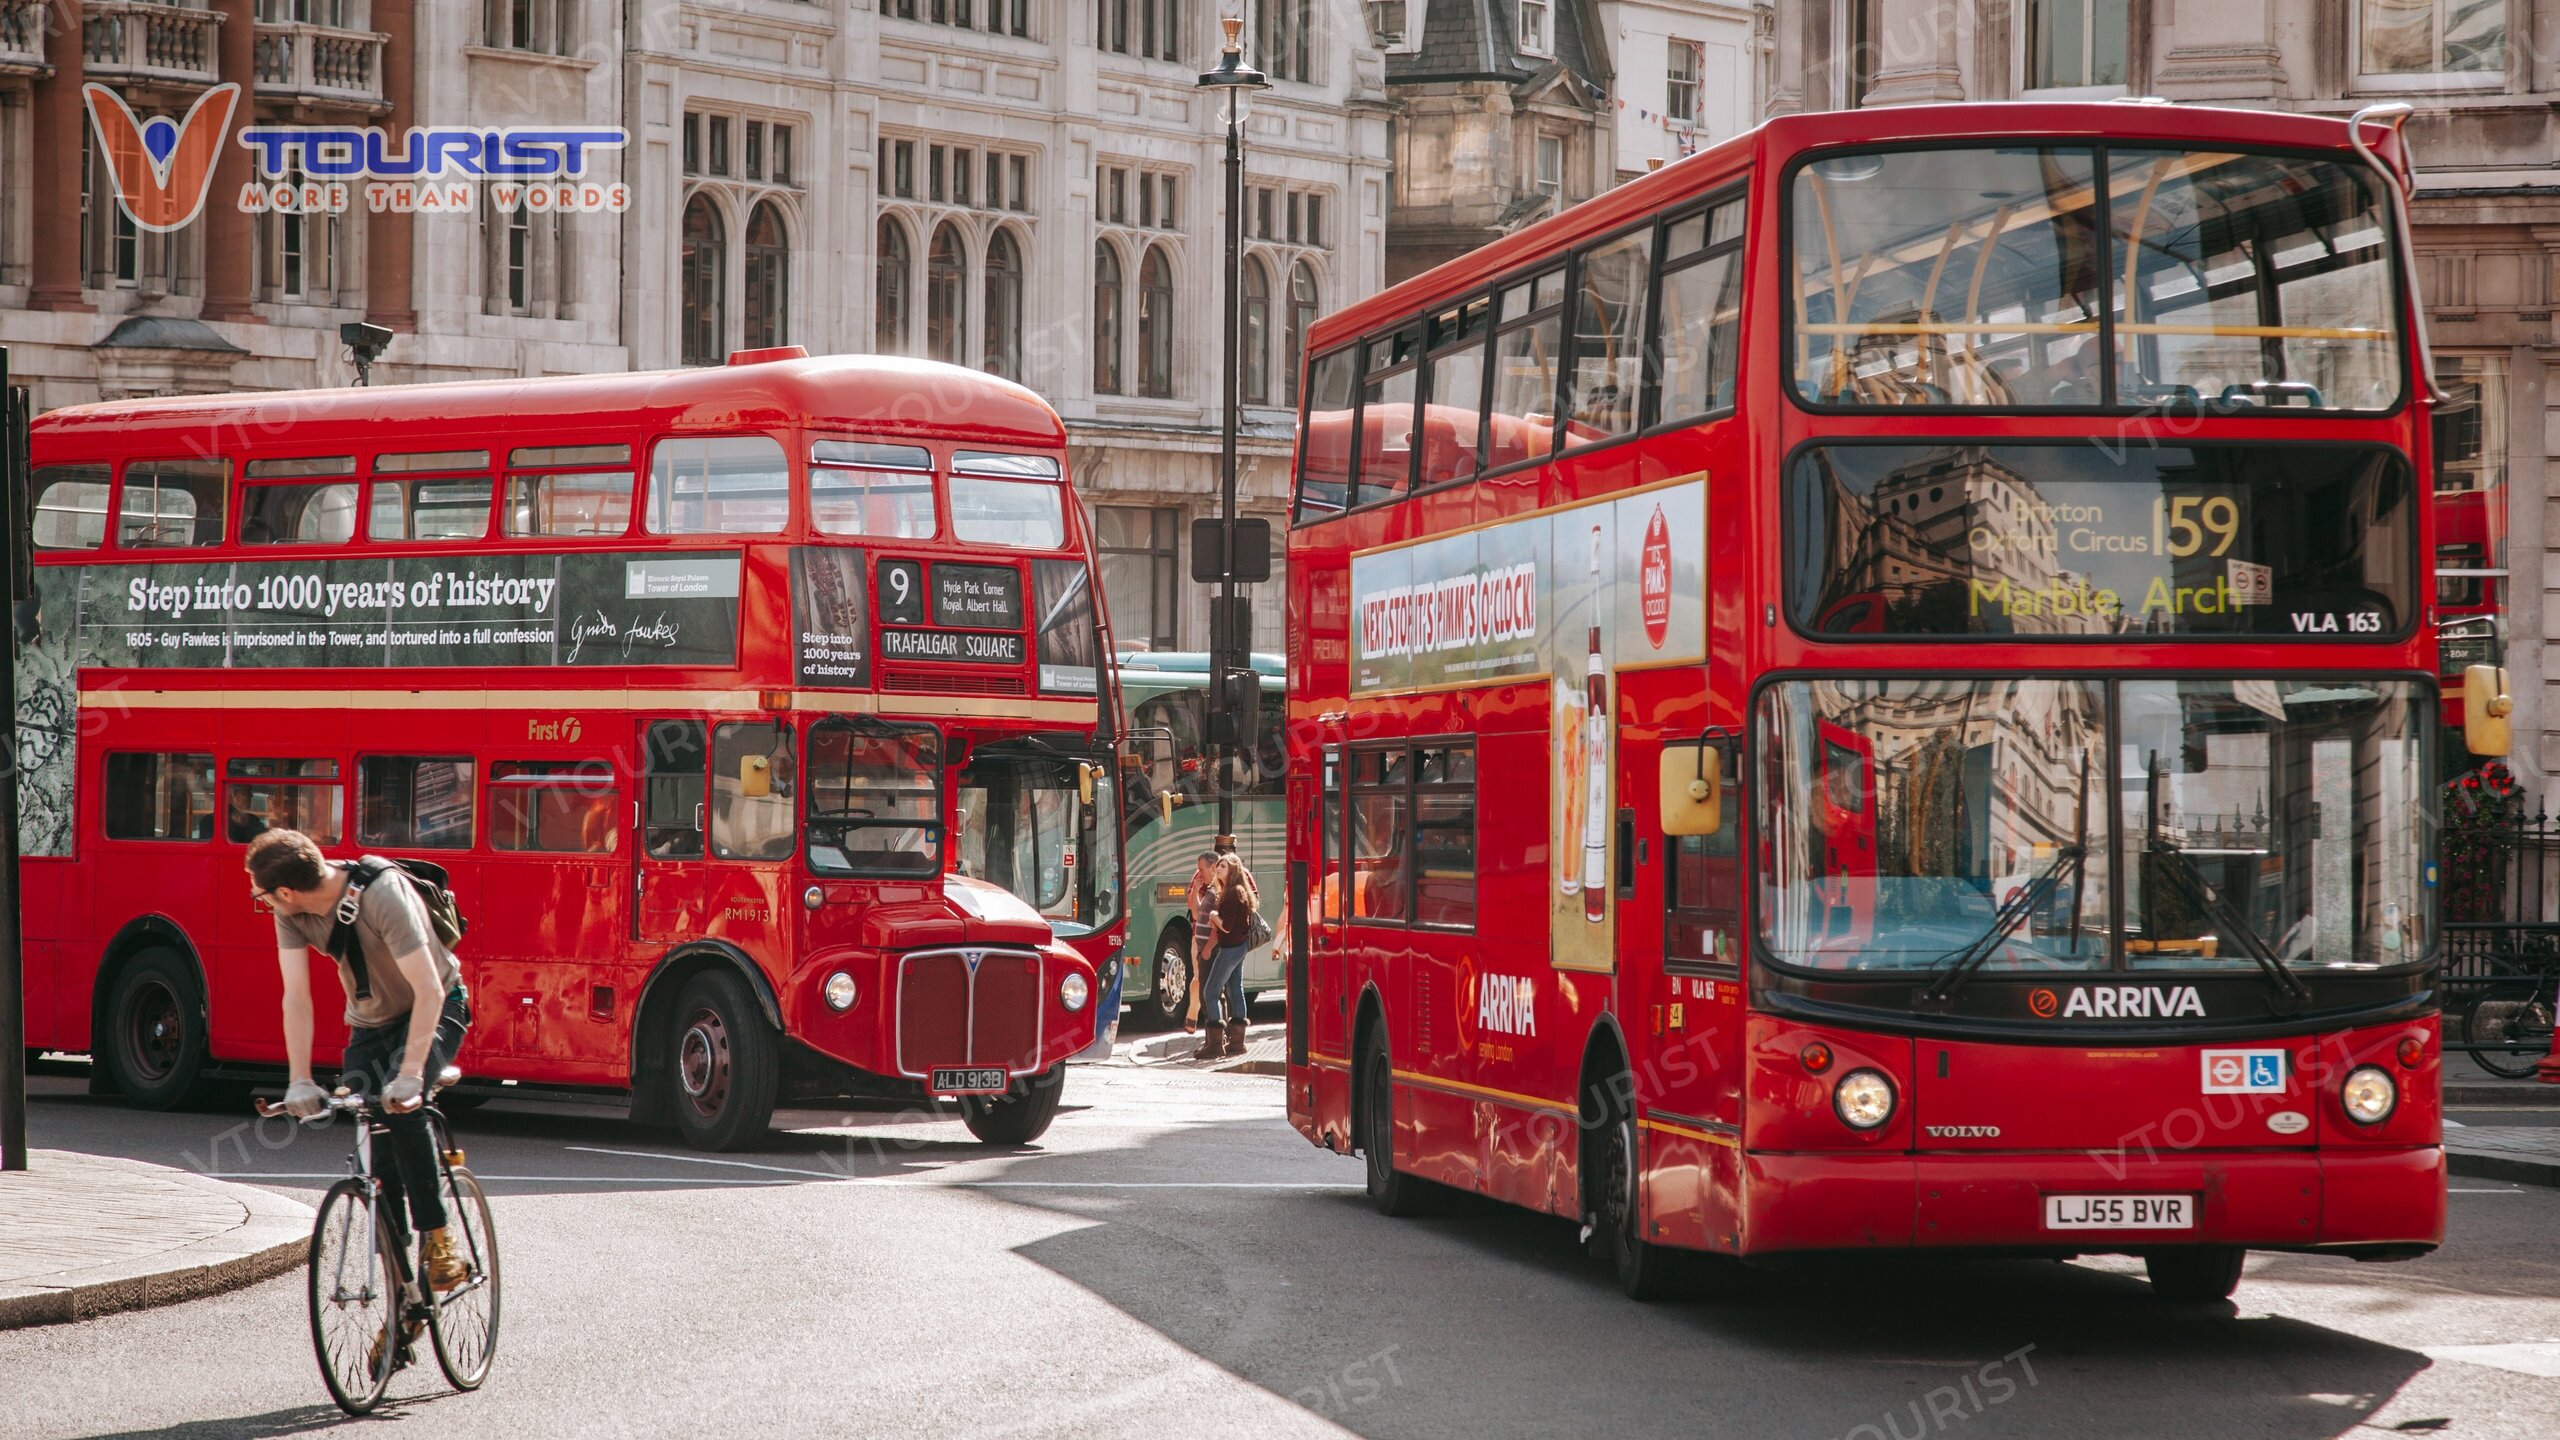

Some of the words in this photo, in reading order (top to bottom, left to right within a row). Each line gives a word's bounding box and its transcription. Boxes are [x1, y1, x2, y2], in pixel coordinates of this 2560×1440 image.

[2013, 497, 2102, 524] Brixton
[2152, 495, 2240, 558] 159
[1968, 526, 2058, 554] Oxford
[2069, 527, 2148, 554] Circus
[127, 577, 190, 618] Step
[193, 577, 251, 610] into
[257, 574, 322, 609] 1000
[325, 581, 405, 617] years
[411, 573, 442, 608] of
[446, 571, 556, 613] history
[647, 583, 670, 592] Tower
[670, 583, 679, 592] of
[679, 582, 708, 592] London
[889, 567, 910, 605] 9
[943, 580, 961, 595] Hyde
[964, 581, 979, 595] Park
[983, 582, 1005, 595] Corner
[1970, 577, 2120, 617] Marble
[2141, 575, 2243, 615] Arch
[943, 597, 963, 612] Royal
[966, 598, 990, 613] Albert
[992, 599, 1008, 613] Hall
[1362, 599, 1386, 654] NEXT
[1414, 591, 1435, 648] IT'S
[1437, 583, 1476, 646] PIMM'S
[1481, 572, 1535, 638] O'CLOCK!
[2291, 612, 2340, 633] VLA
[2346, 612, 2382, 633] 163
[126, 632, 152, 647] 1605
[161, 632, 180, 649] Guy
[182, 632, 220, 648] Fawkes
[222, 631, 232, 647] is
[233, 631, 295, 648] imprisoned
[296, 630, 306, 646] in
[308, 630, 326, 646] the
[329, 630, 363, 647] Tower,
[365, 630, 386, 646] and
[390, 629, 437, 646] tortured
[439, 628, 460, 644] into
[463, 632, 471, 644] a
[472, 628, 491, 644] full
[492, 628, 554, 644] confession
[802, 632, 829, 647] Step
[830, 633, 852, 644] into
[885, 631, 958, 655] TRAFALGAR
[966, 635, 1016, 658] SQUARE
[804, 648, 830, 660] 1000
[831, 650, 861, 663] years
[803, 663, 816, 675] of
[817, 664, 856, 678] history
[528, 719, 559, 740] First
[725, 907, 770, 922] RM1913
[1478, 972, 1536, 1037] ARRIVA
[2062, 986, 2206, 1018] ARRIVA
[936, 1072, 965, 1089] ALD
[967, 1072, 1001, 1088] 913B
[1925, 1125, 2001, 1138] VOLVO
[2056, 1199, 2125, 1223] LJ55
[2132, 1199, 2182, 1223] BVR
